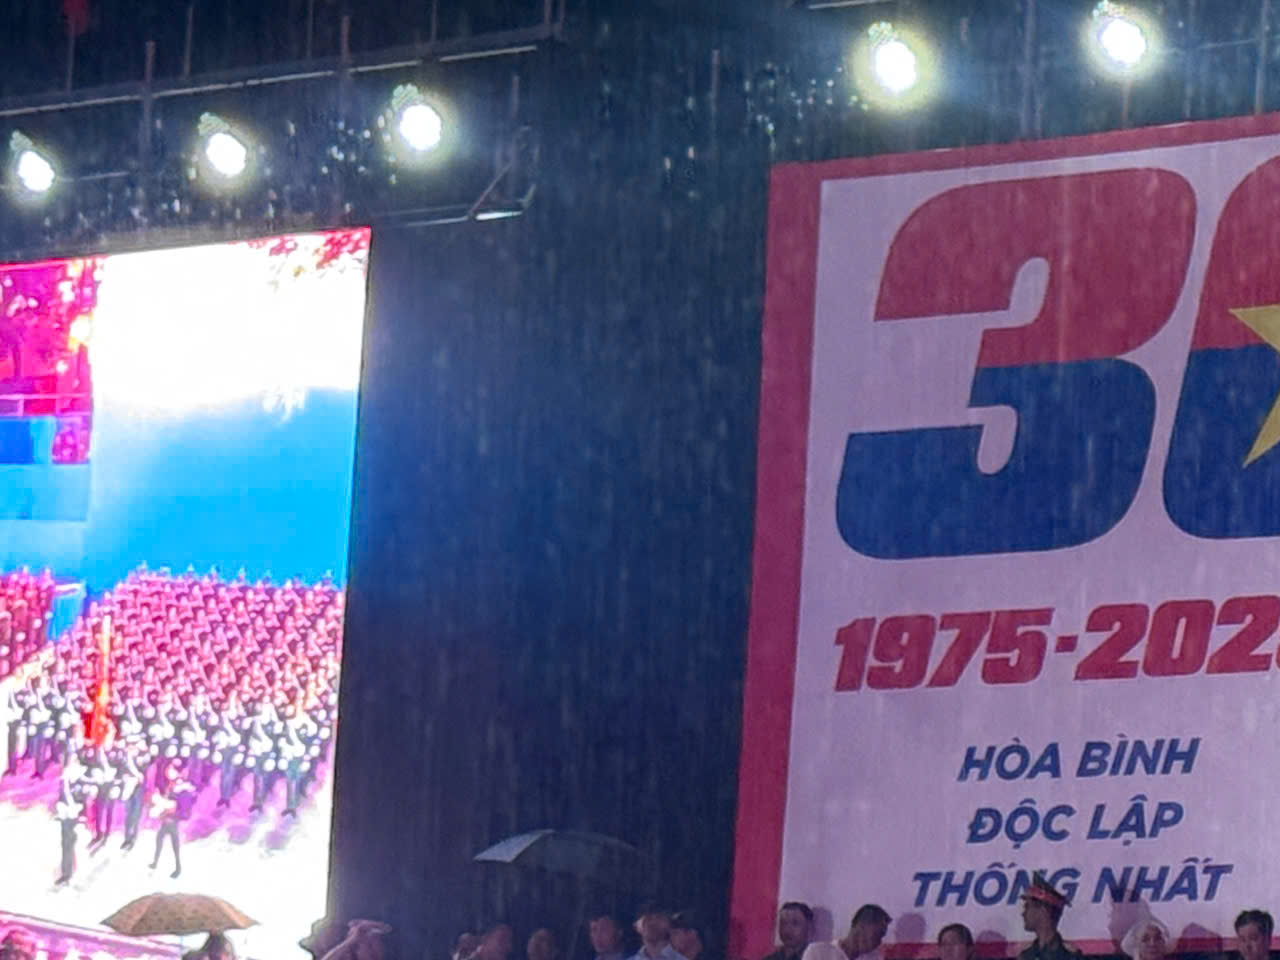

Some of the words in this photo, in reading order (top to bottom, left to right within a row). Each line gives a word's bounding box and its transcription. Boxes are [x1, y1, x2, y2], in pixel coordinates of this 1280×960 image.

[957, 737, 1062, 781] HÒA
[1076, 733, 1202, 777] BÌNH
[966, 798, 1076, 849] ĐỘC
[1086, 794, 1184, 846] LẬP
[1092, 857, 1233, 904] NHẤT
